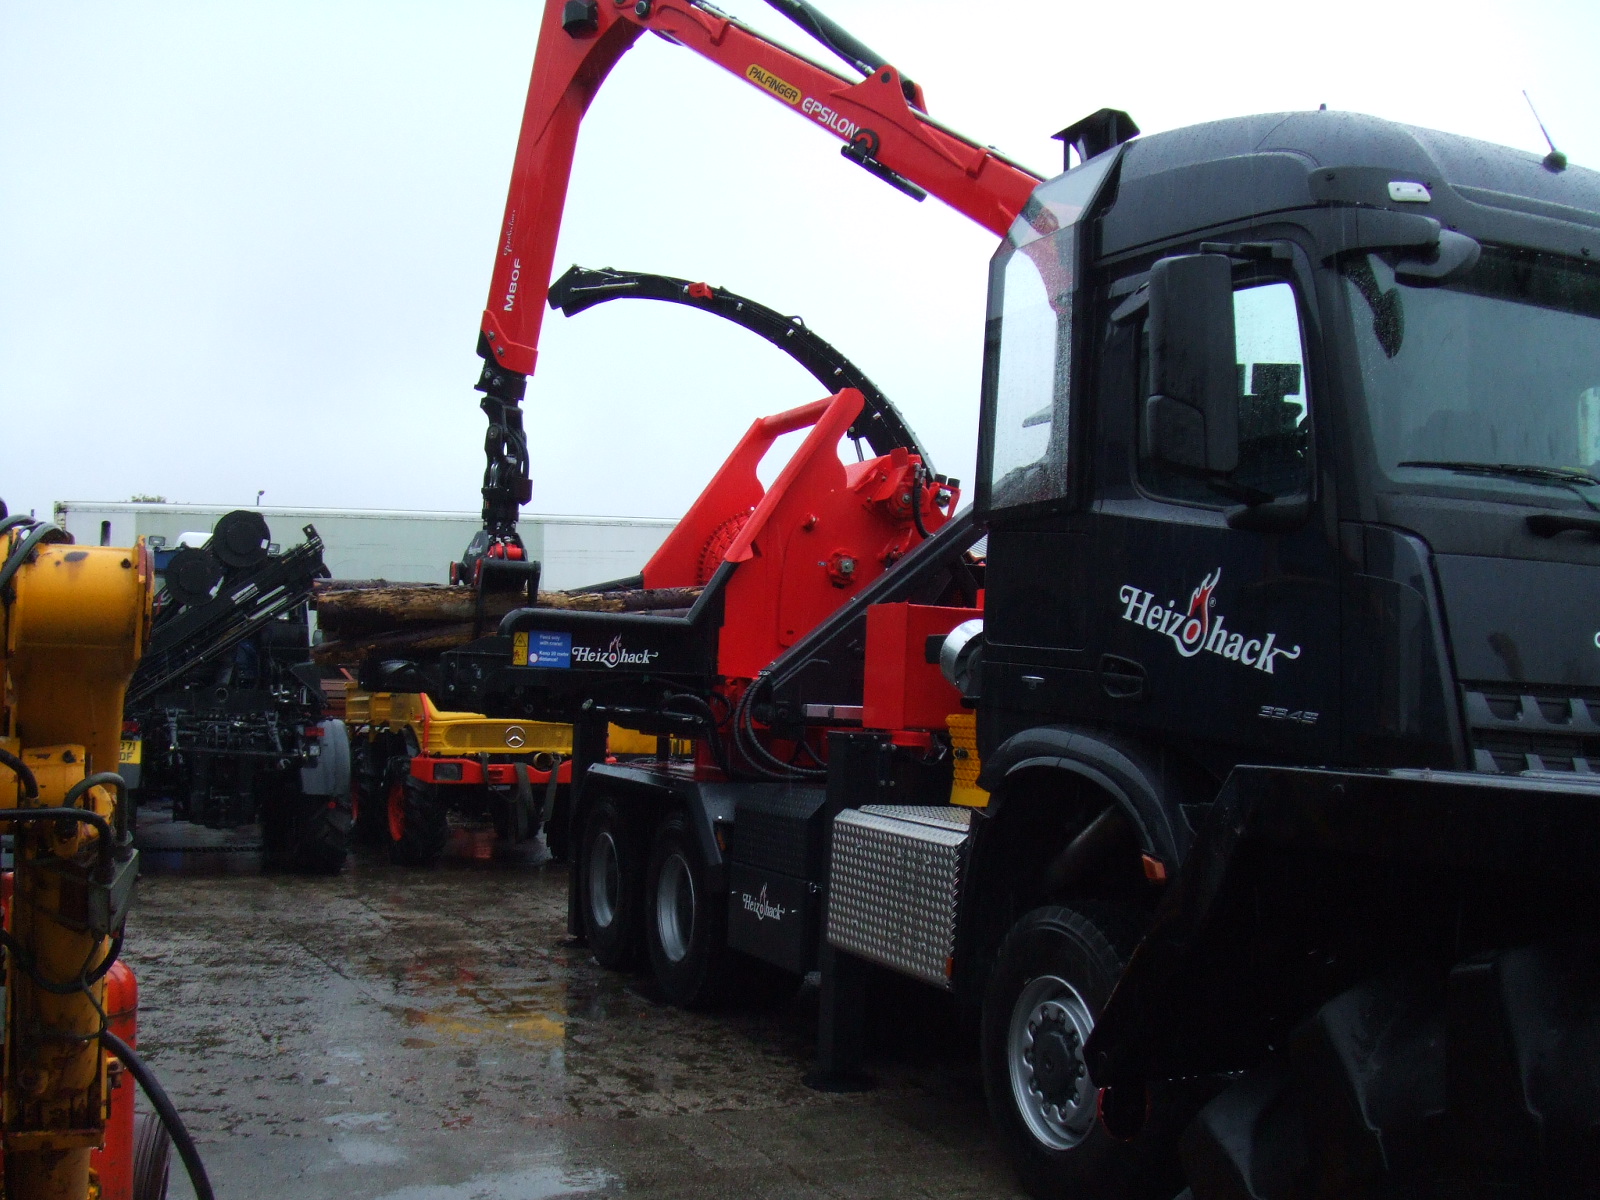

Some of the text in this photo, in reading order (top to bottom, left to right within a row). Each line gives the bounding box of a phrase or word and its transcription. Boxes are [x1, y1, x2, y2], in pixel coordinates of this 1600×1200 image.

[748, 66, 798, 102] PALFINGER
[801, 97, 860, 139] EPSILON
[503, 258, 521, 312] M80F
[1119, 571, 1301, 675] Heizohack
[571, 637, 659, 668] Heizohack
[742, 886, 786, 920] Heizohack
